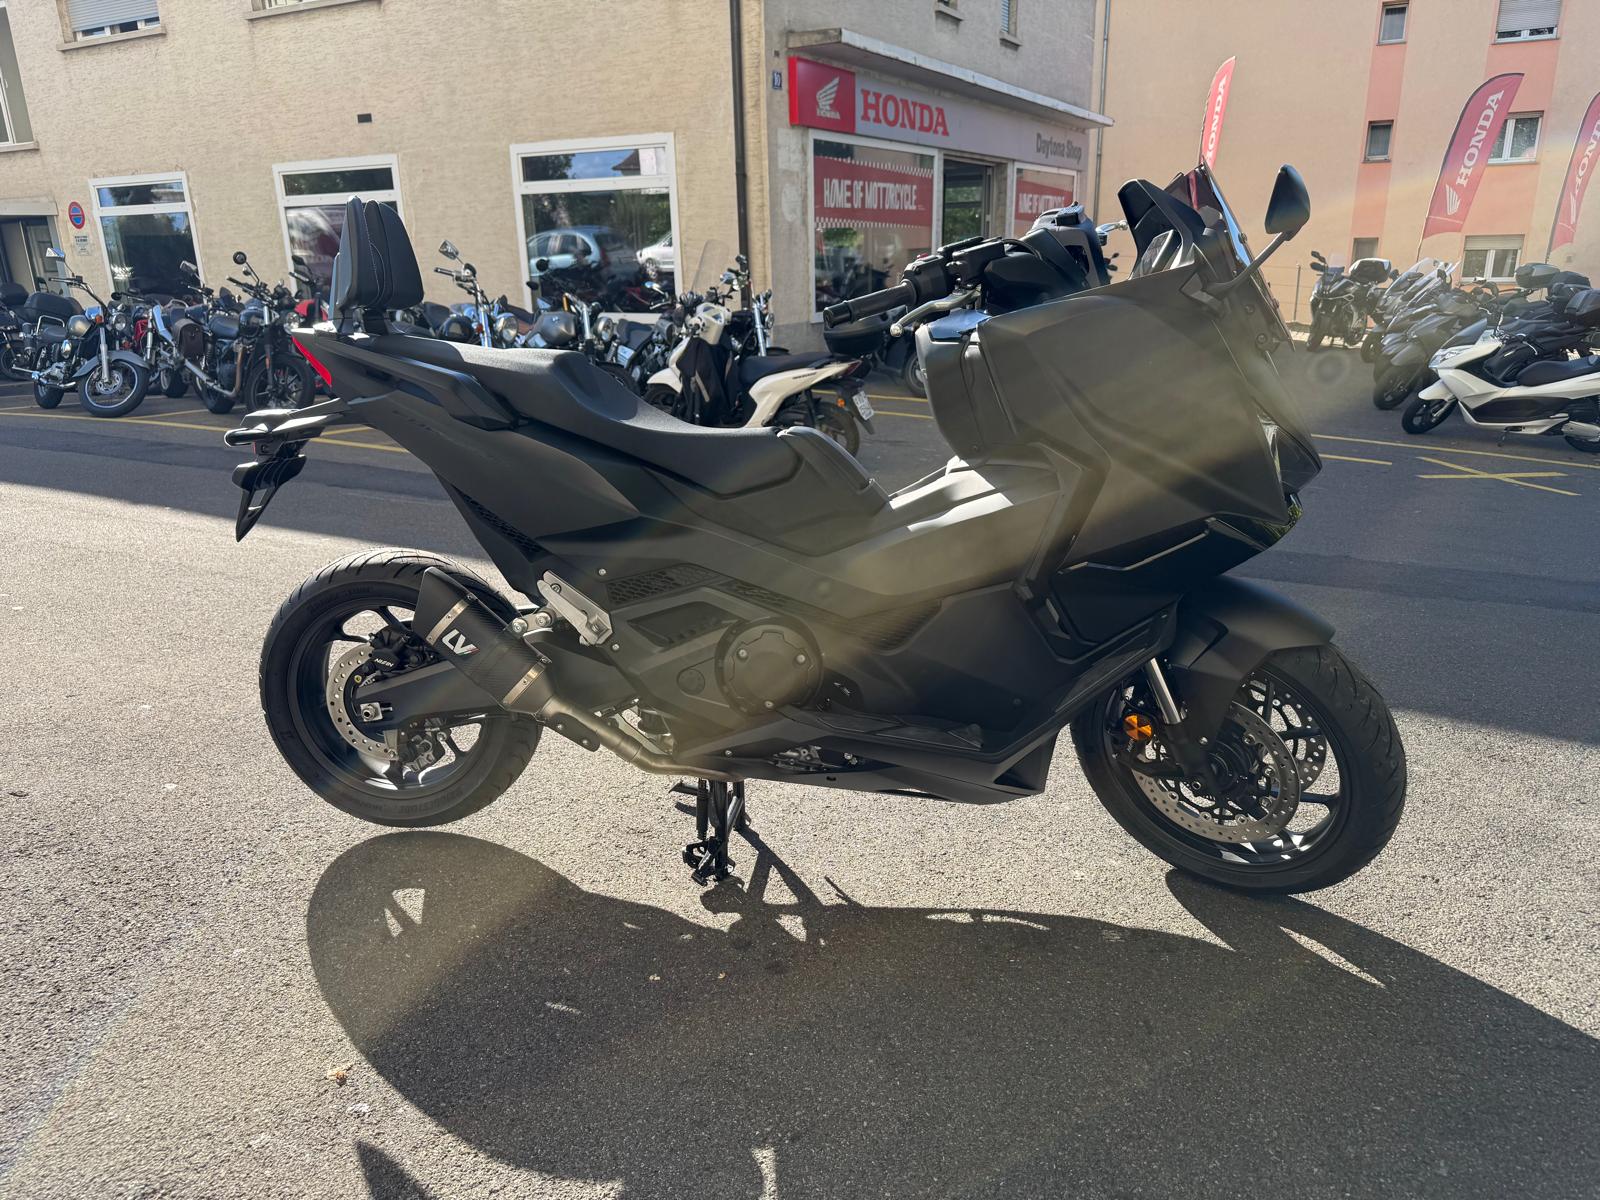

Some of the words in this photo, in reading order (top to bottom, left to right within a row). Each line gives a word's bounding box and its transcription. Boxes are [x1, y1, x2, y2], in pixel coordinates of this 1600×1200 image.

[861, 88, 950, 137] HONDA
[1455, 90, 1505, 188] HONDA
[824, 178, 852, 208] HOME
[853, 180, 864, 209] OF
